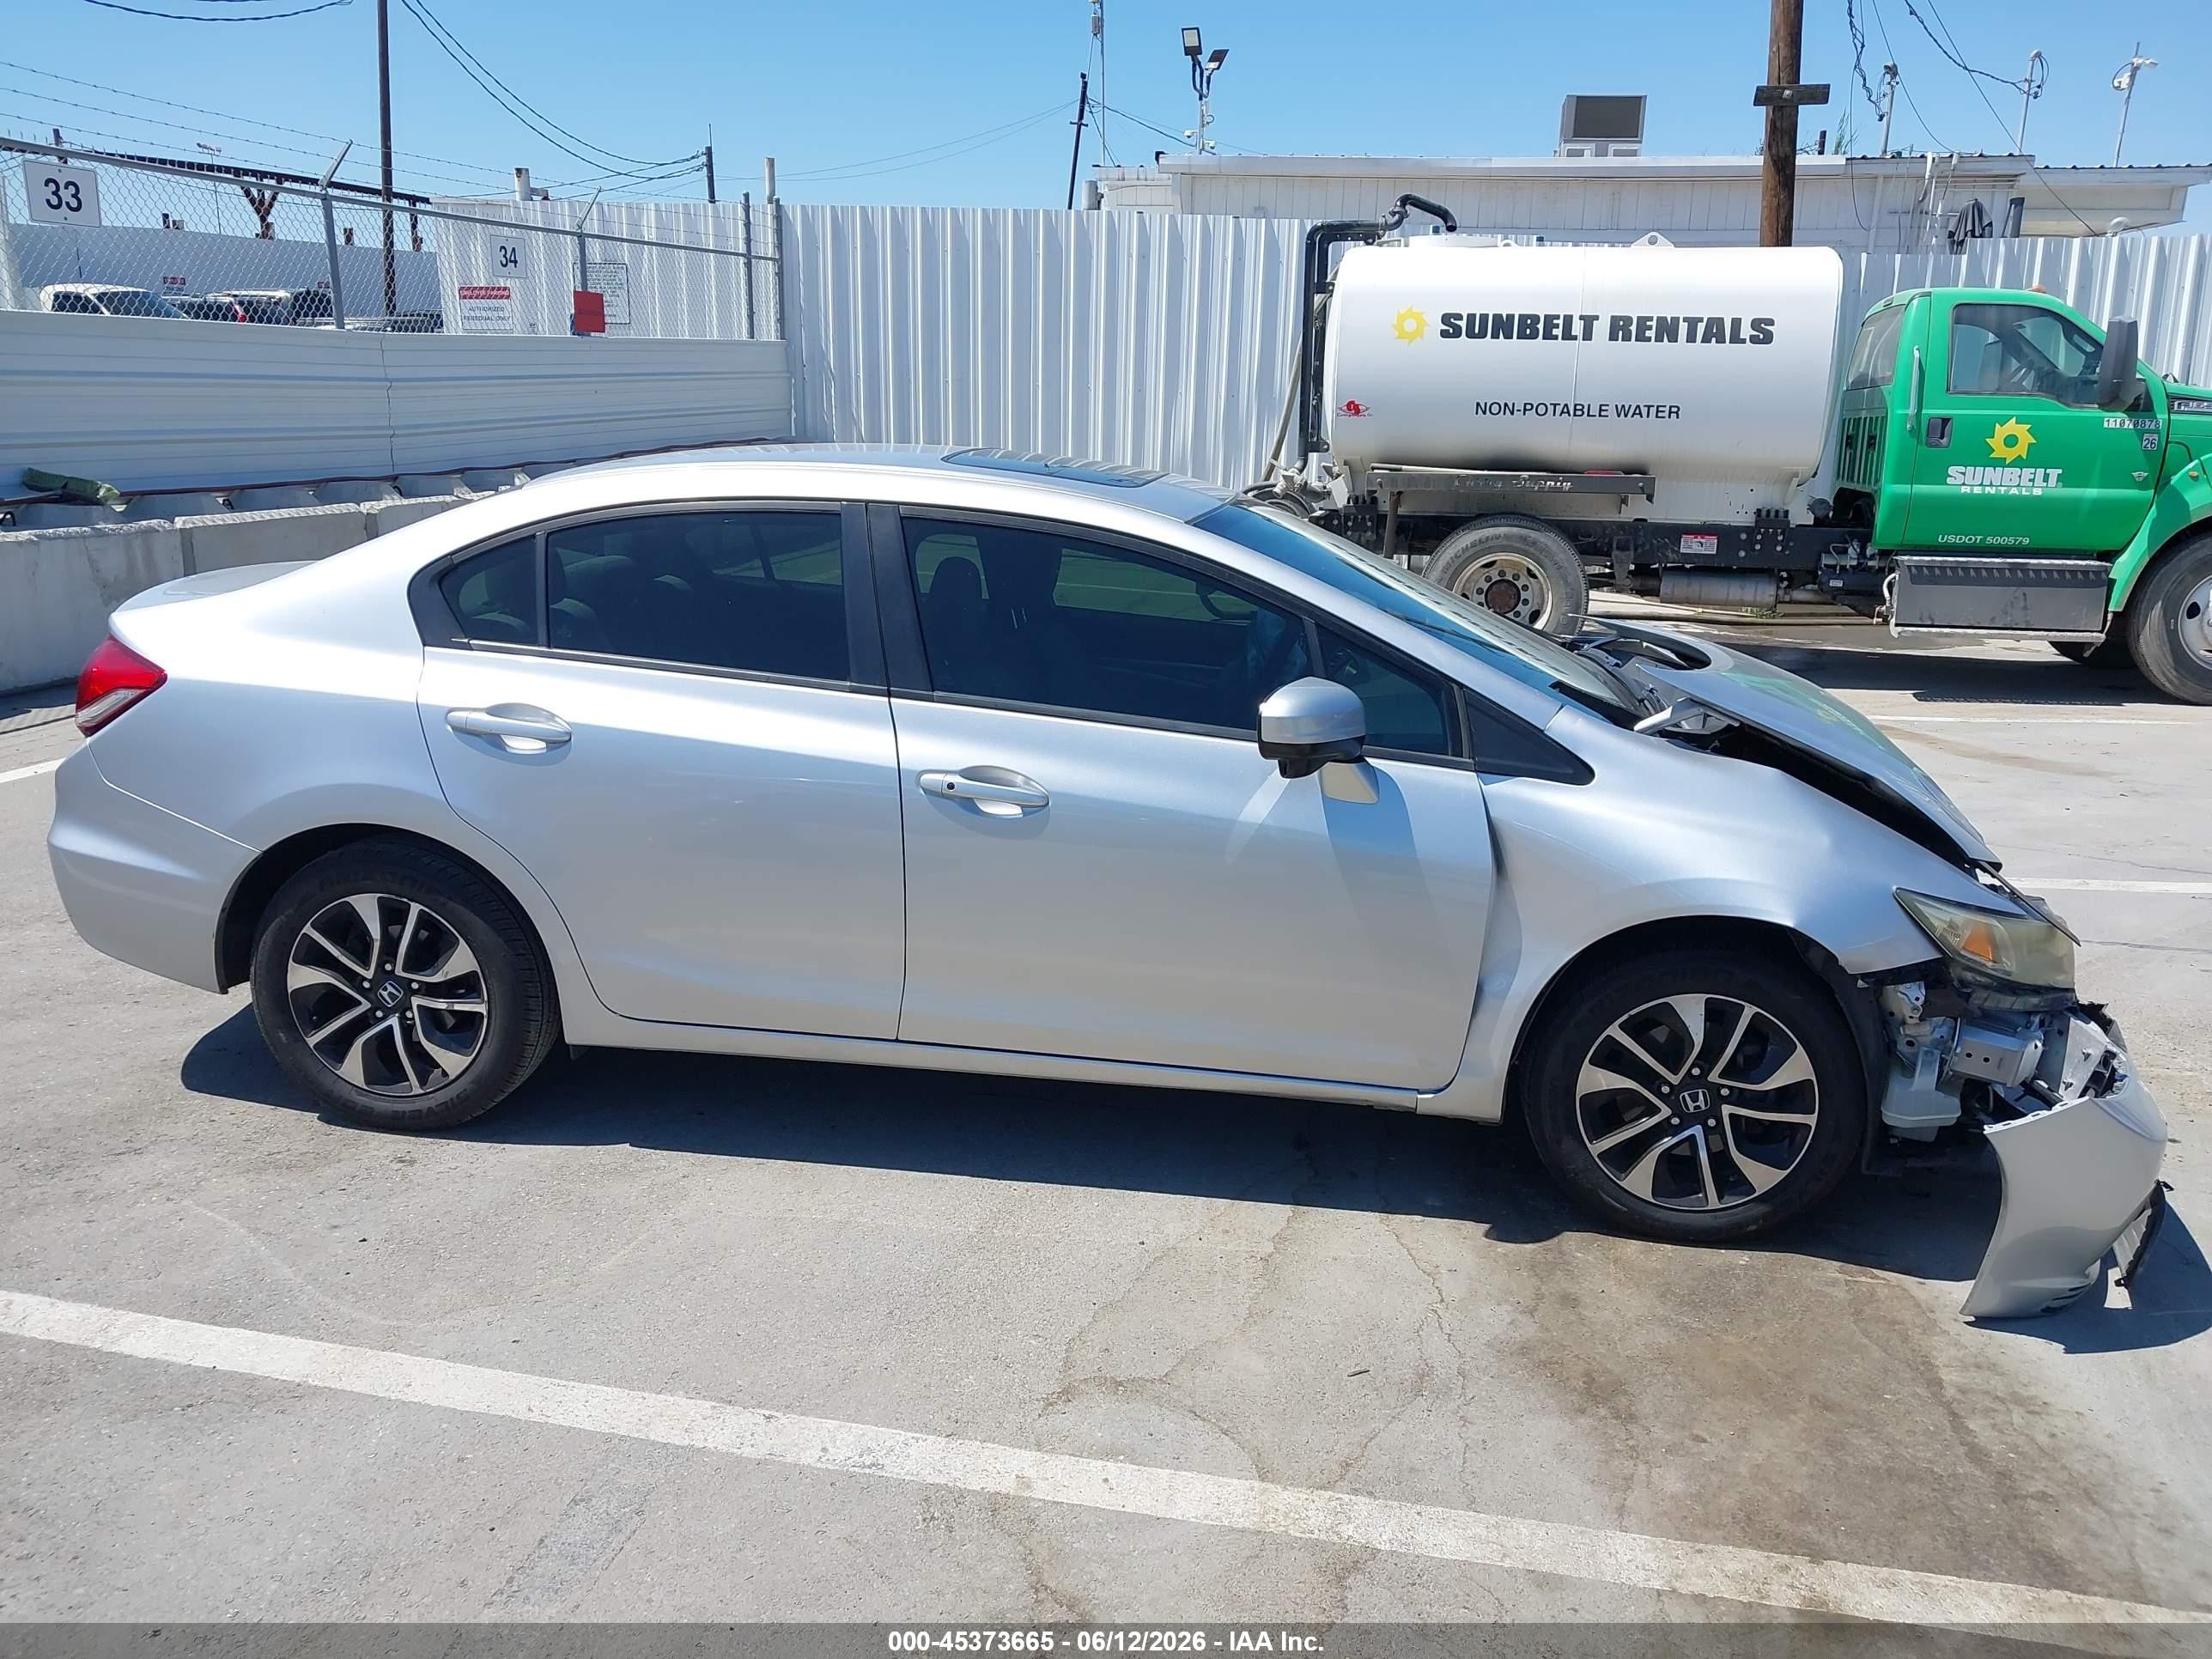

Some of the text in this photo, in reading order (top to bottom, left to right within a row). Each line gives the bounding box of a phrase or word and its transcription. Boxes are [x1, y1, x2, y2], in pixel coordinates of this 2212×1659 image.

[44, 177, 82, 213] 33
[499, 245, 519, 269] 34
[1439, 312, 1776, 345] SUNBELT RENTALS
[1474, 401, 1681, 420] NON-POTABLE WATER
[2105, 418, 2161, 429] 11070878
[2142, 437, 2157, 450] 26
[1946, 465, 2063, 488] SUNBELT
[1960, 485, 2043, 495] RENTALS
[1937, 534, 2030, 545] USDOT 500579
